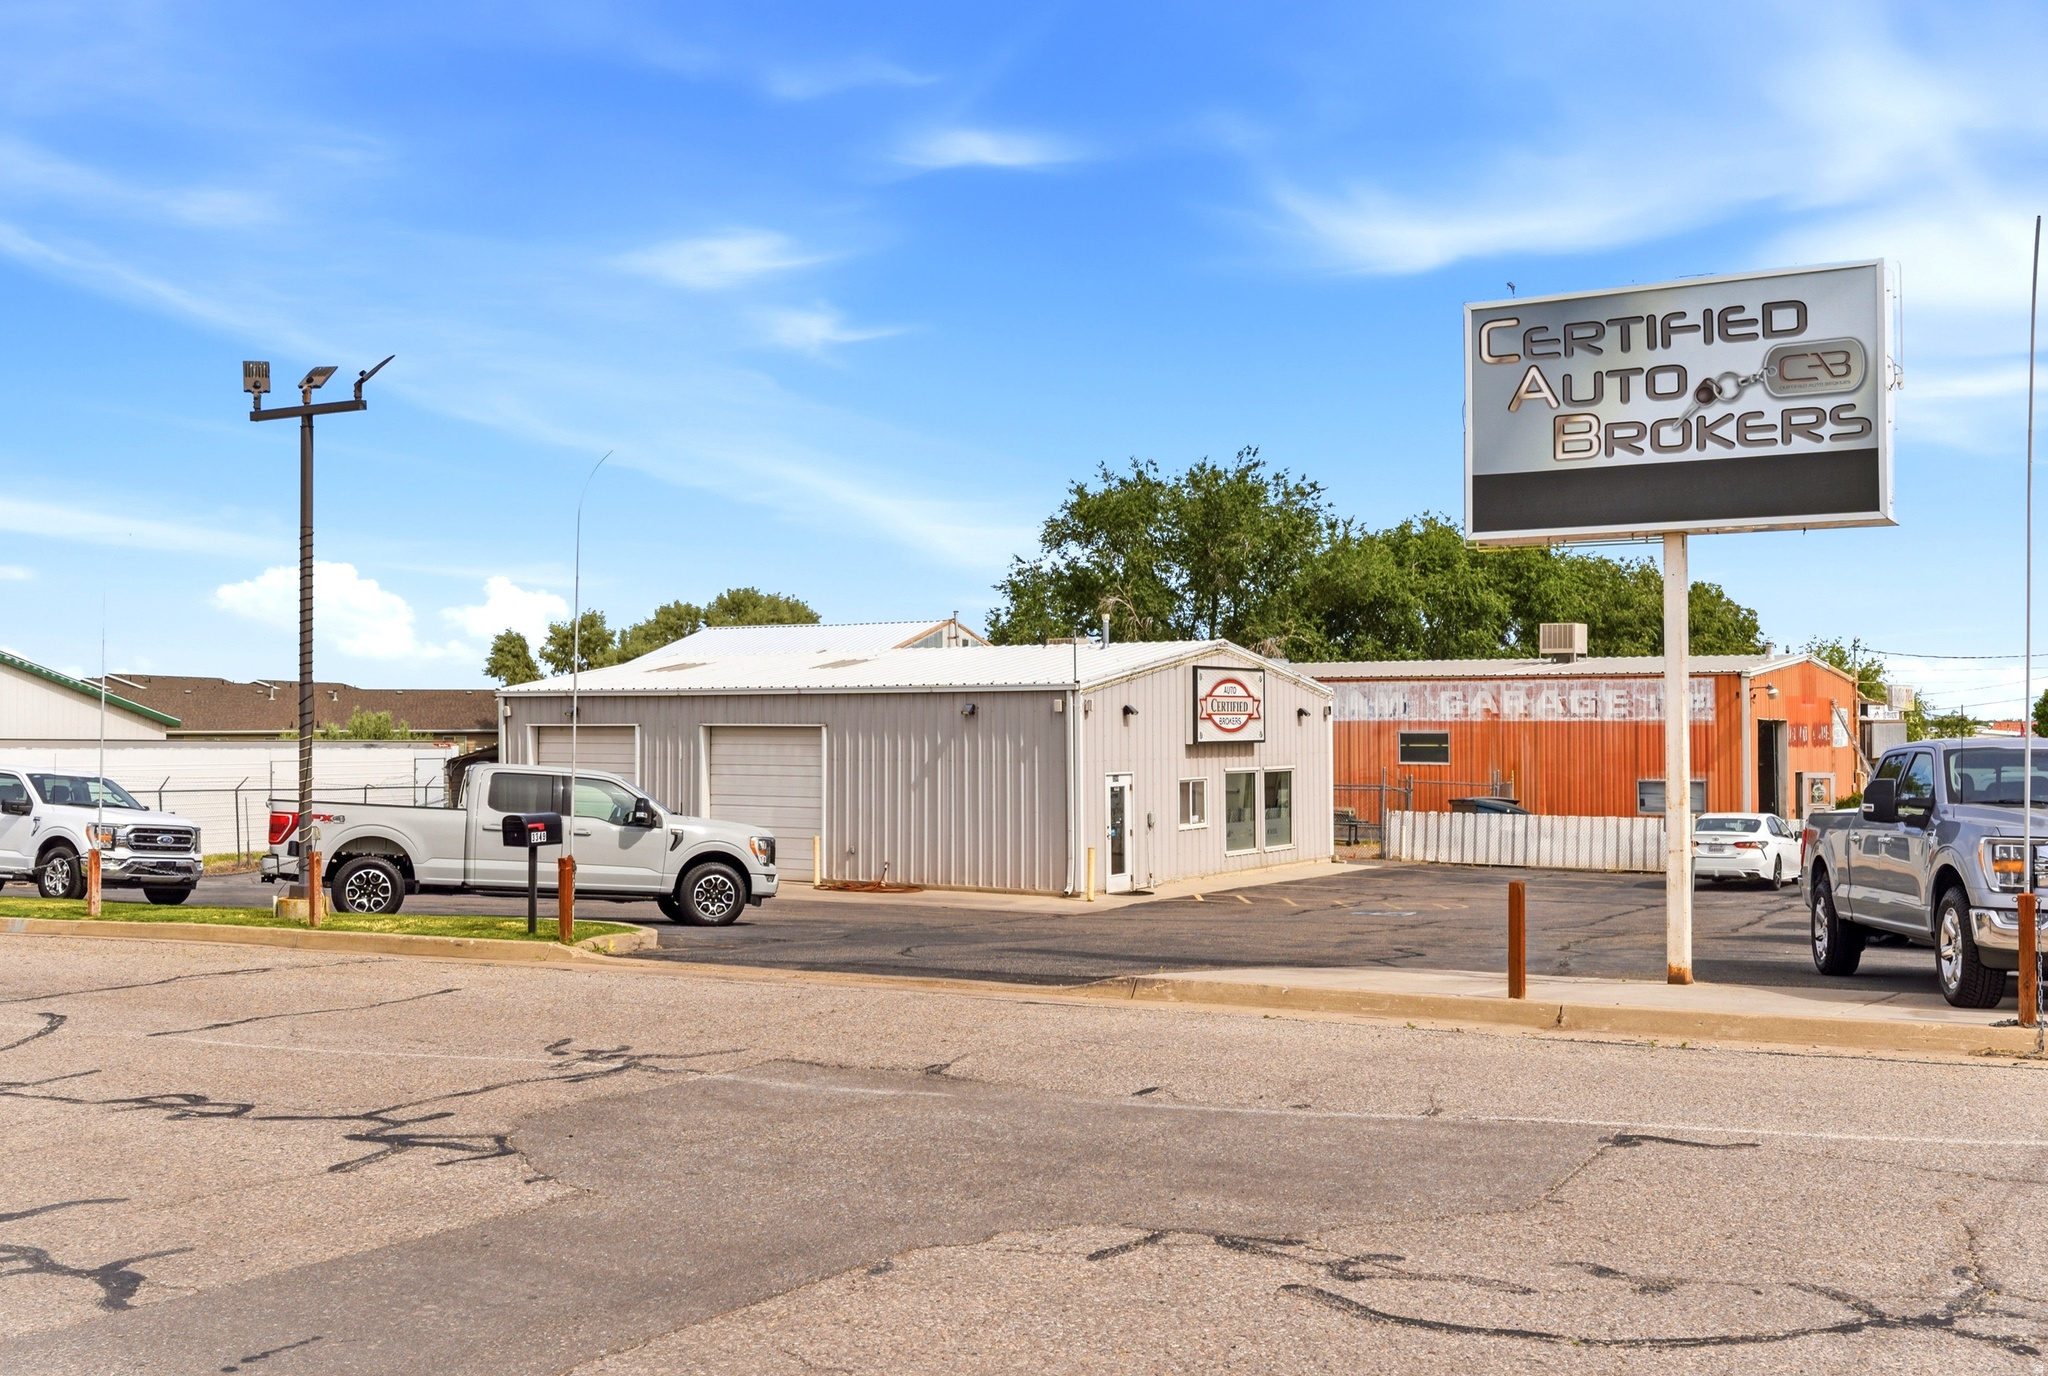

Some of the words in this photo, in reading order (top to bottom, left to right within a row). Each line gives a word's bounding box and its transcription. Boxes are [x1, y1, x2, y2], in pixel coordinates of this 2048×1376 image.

[1479, 300, 1807, 364] CERTIFIED
[1508, 364, 1688, 413] AUTO
[1553, 403, 1873, 461] BROKERS
[1211, 698, 1248, 712] CERTIFIED
[1224, 686, 1237, 694] AUTO
[1219, 717, 1241, 725] BROKERS
